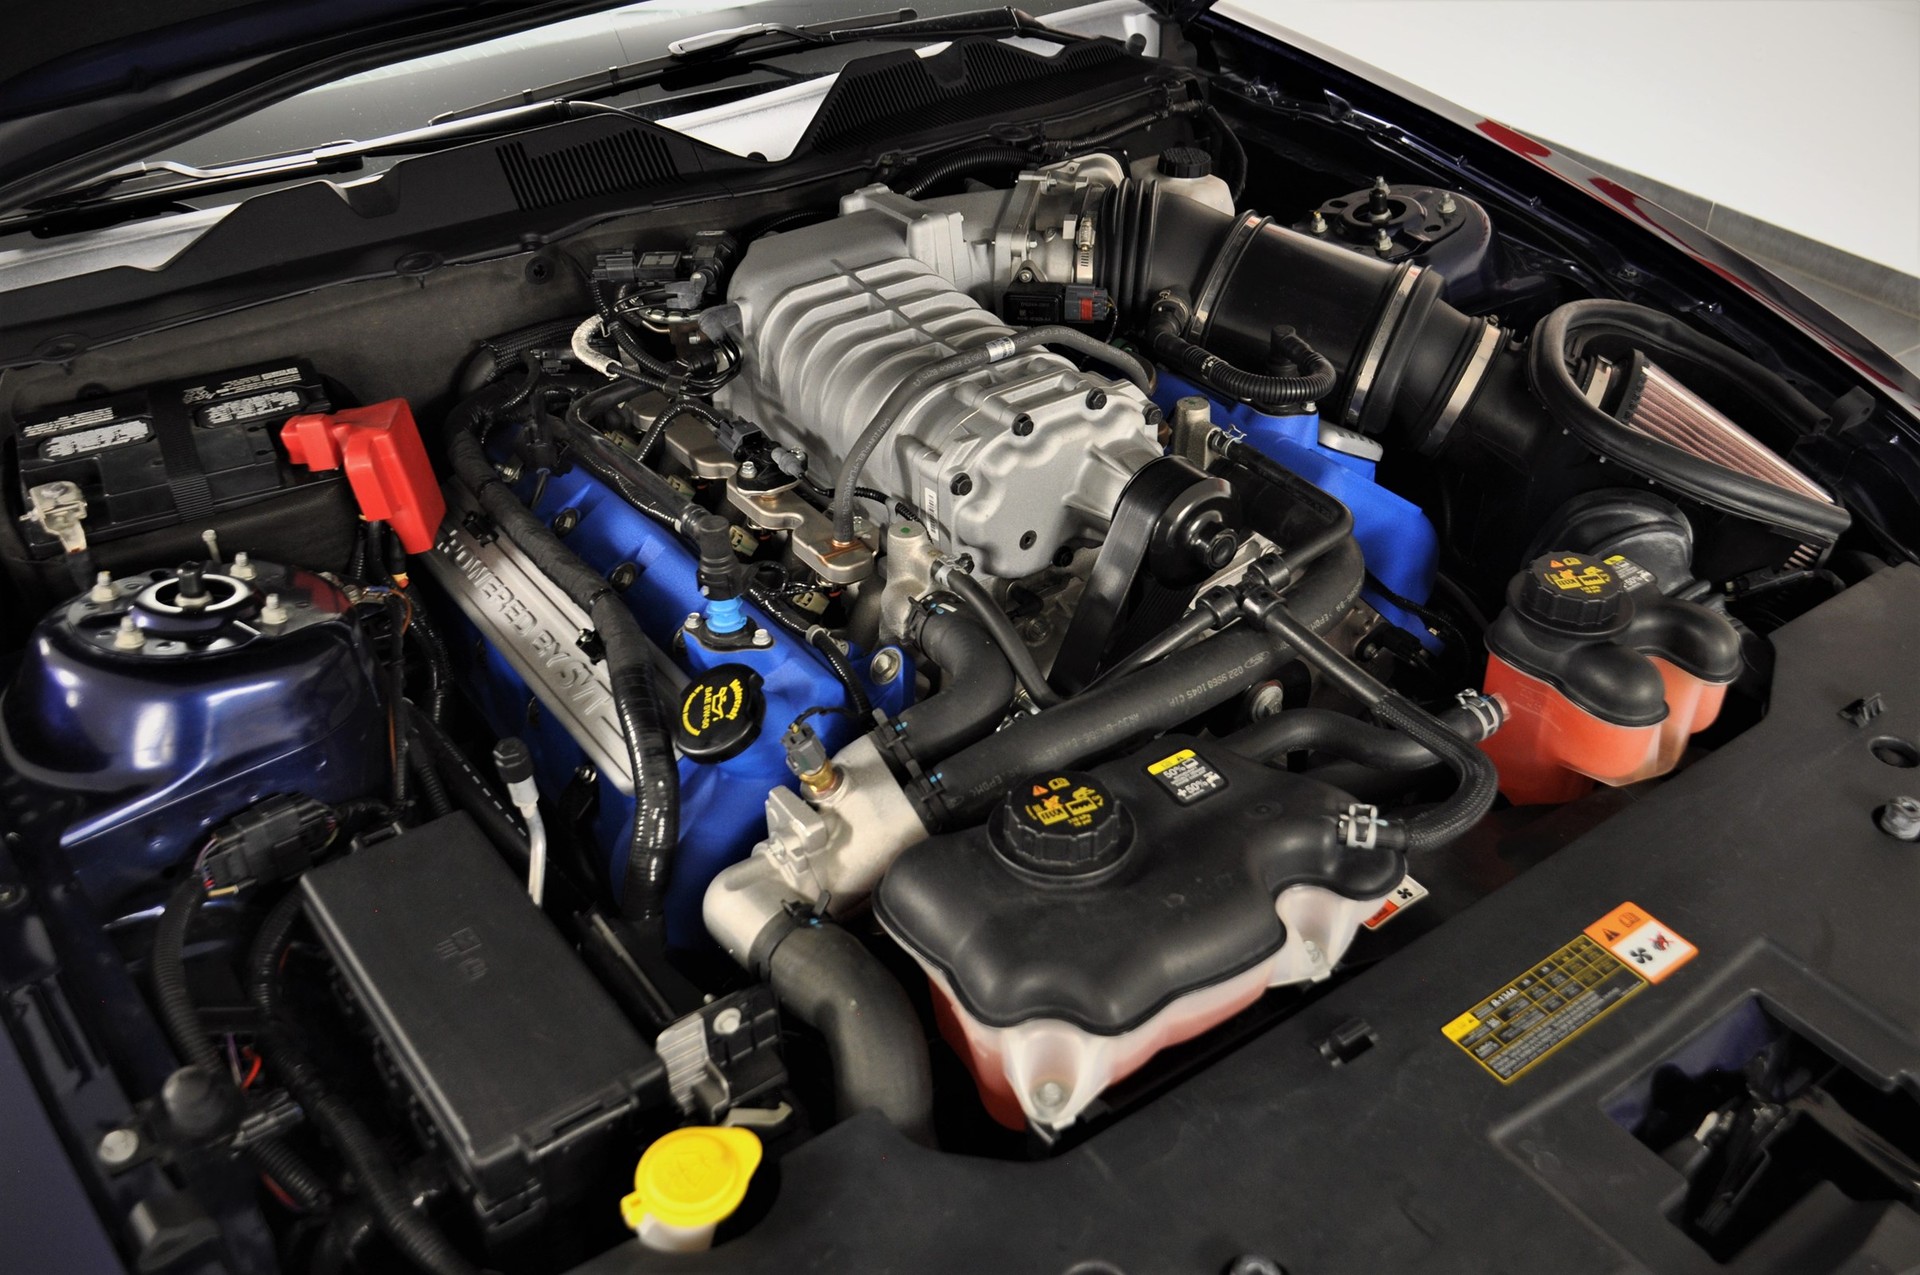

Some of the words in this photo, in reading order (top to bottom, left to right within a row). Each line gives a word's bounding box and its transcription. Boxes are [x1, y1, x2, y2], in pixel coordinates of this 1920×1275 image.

[437, 529, 538, 637] POWERED
[532, 629, 571, 668] BY
[556, 660, 614, 716] SVT
[1228, 665, 1244, 680] 022
[704, 686, 713, 704] SAE
[726, 678, 743, 720] Motorcraft
[1186, 682, 1207, 700] 1045
[1163, 765, 1186, 779] 50%
